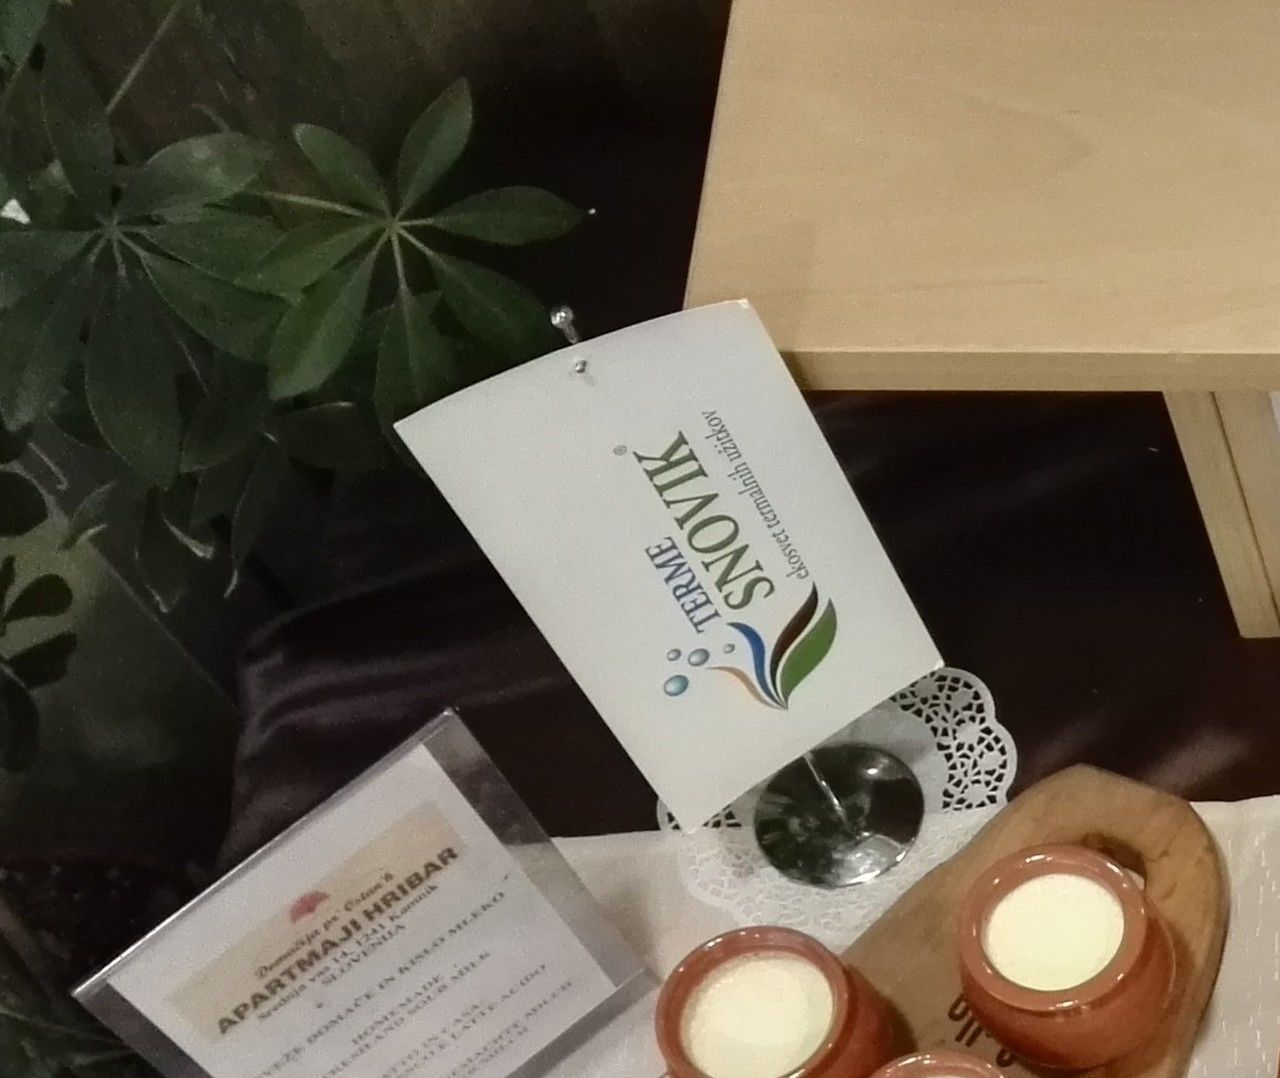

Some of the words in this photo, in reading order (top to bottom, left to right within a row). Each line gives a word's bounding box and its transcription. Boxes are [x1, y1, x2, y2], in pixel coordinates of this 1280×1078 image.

[702, 409, 742, 462] užitkov
[633, 430, 775, 611] SNOVIK
[727, 461, 781, 529] termalnih
[645, 535, 723, 634] TERME
[772, 529, 810, 580] ekosvet
[214, 917, 362, 1035] APARTMAJI
[361, 844, 459, 923] HRIBAR
